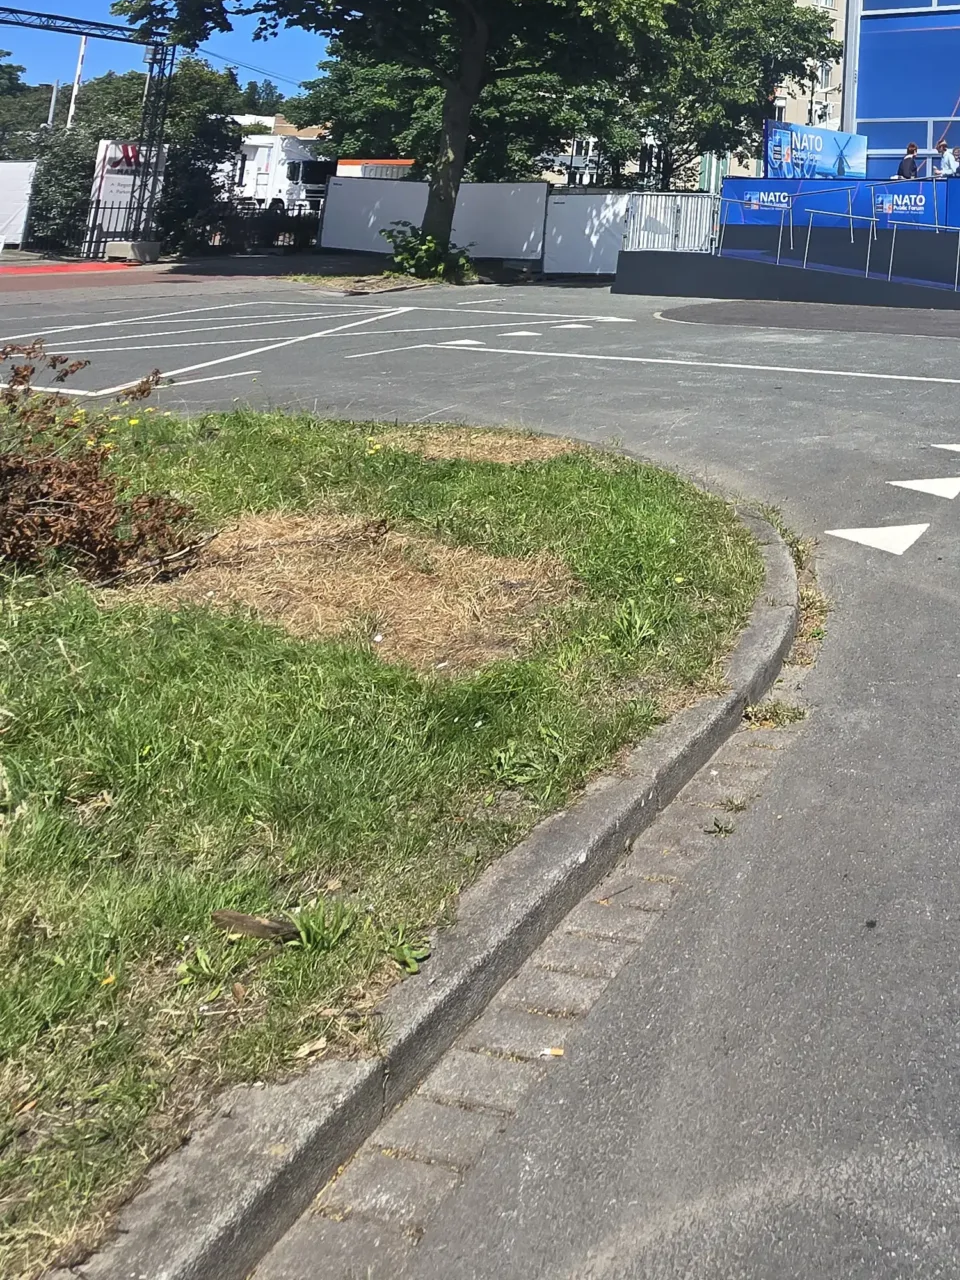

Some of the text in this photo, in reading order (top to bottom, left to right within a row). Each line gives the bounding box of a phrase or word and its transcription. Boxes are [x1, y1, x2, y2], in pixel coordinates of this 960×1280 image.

[792, 132, 822, 151] NATO
[760, 192, 788, 202] NATO
[893, 194, 925, 205] NATO
